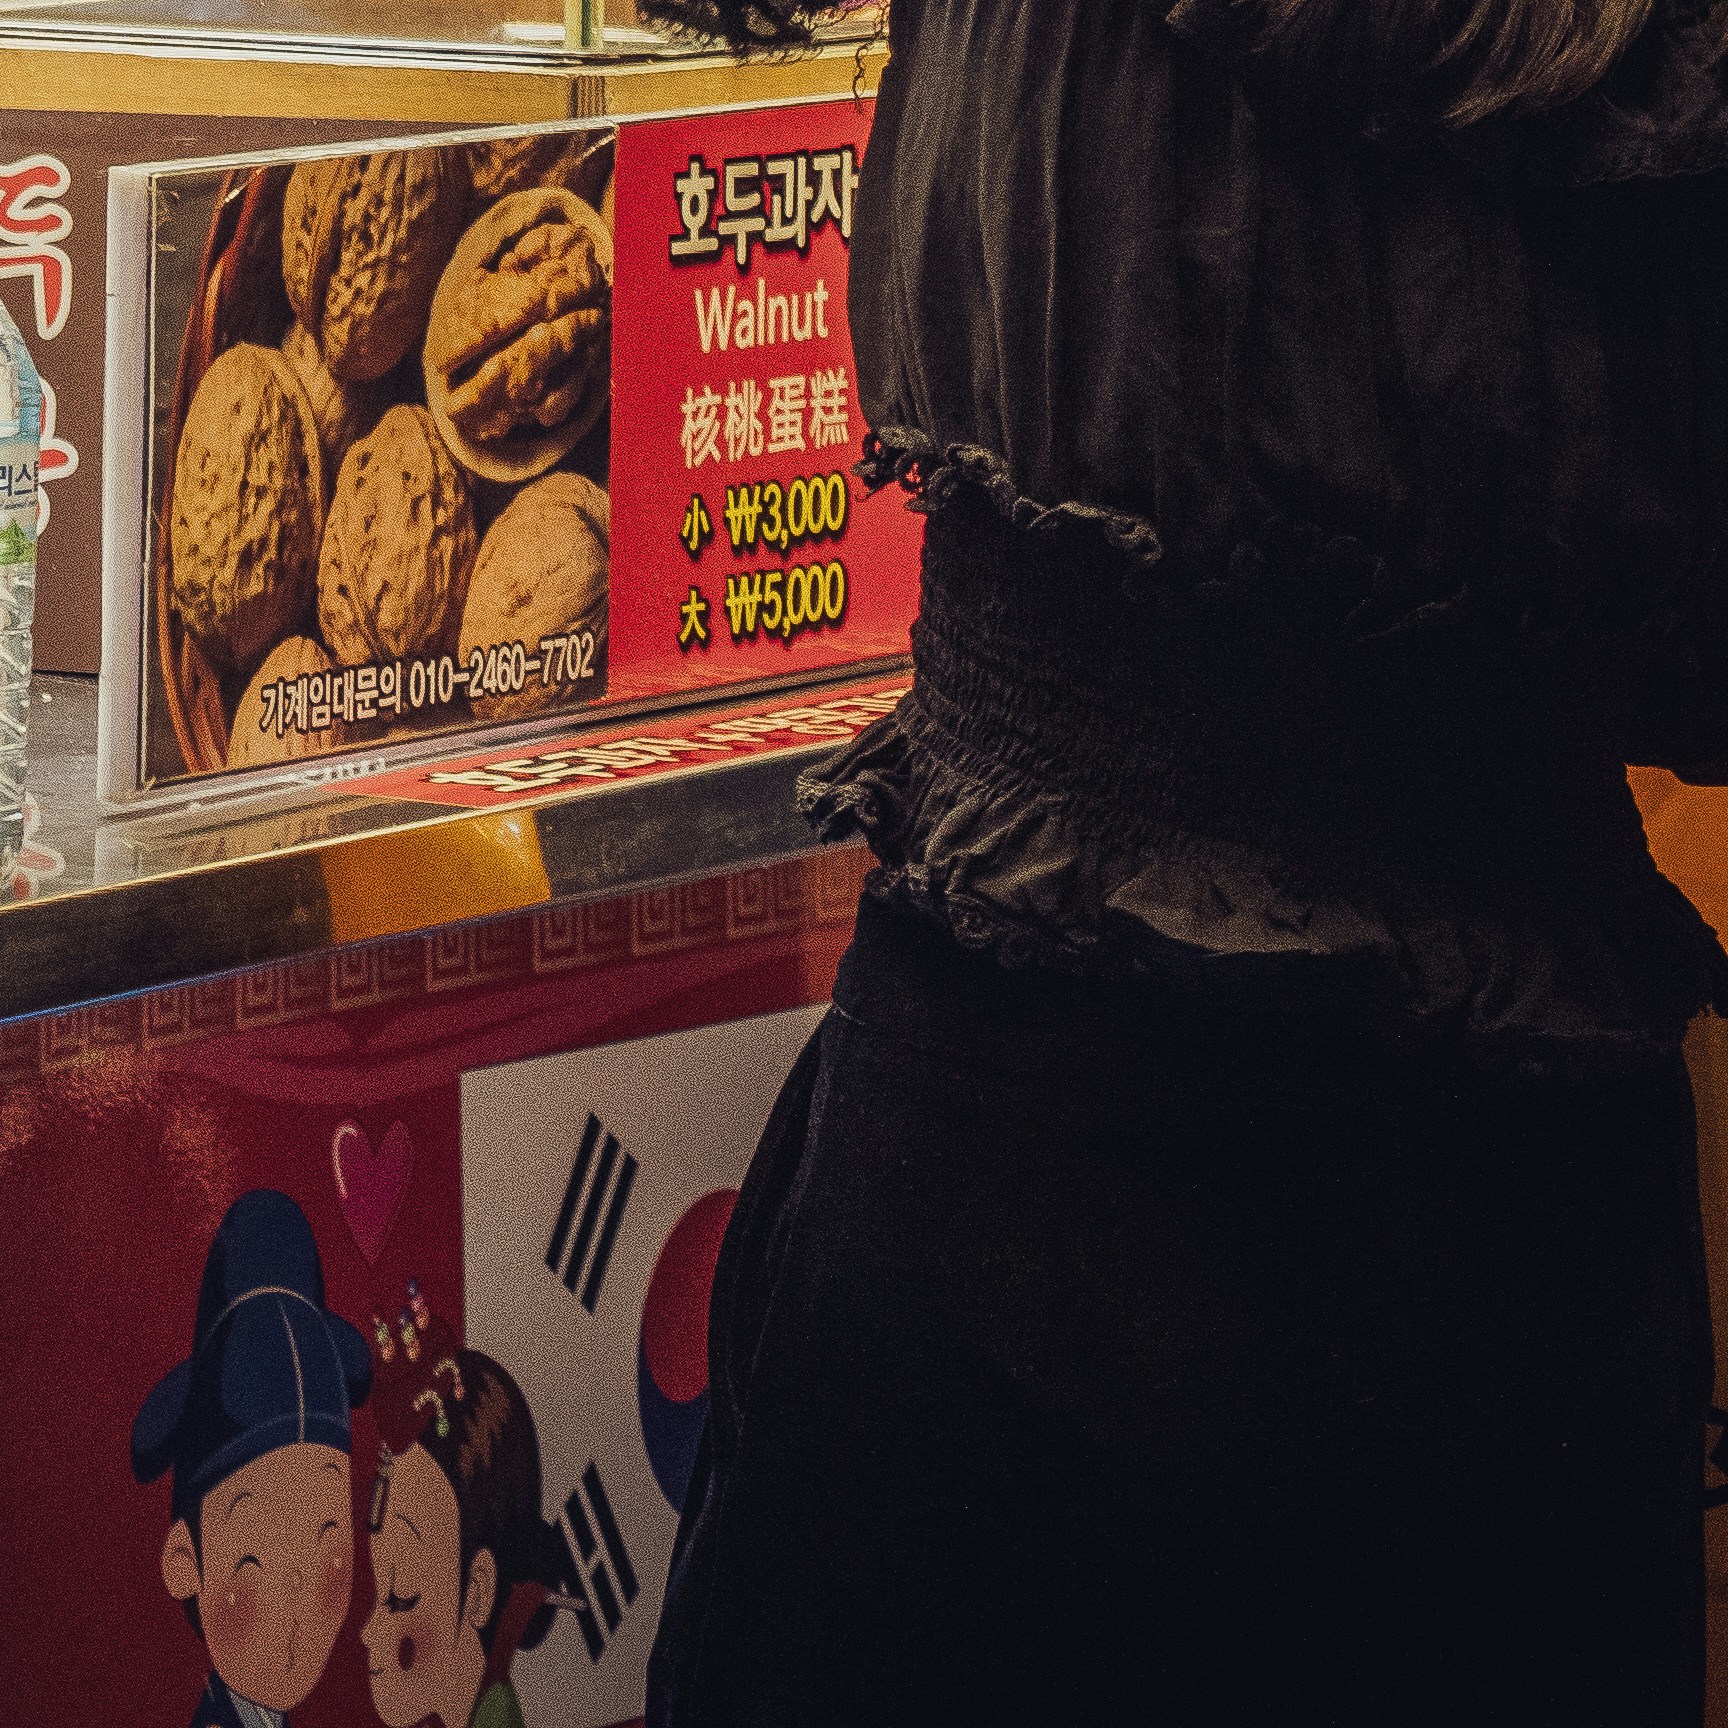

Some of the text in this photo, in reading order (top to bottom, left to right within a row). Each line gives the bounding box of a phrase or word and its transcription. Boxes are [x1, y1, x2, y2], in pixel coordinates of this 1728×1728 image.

[670, 145, 861, 267] 호두과자
[693, 280, 831, 355] Walnut
[679, 367, 850, 469] 核桃蛋糕
[680, 503, 712, 560] 小
[678, 590, 710, 648] 大
[259, 631, 597, 737] 기계임대문의 010-2460-7702
